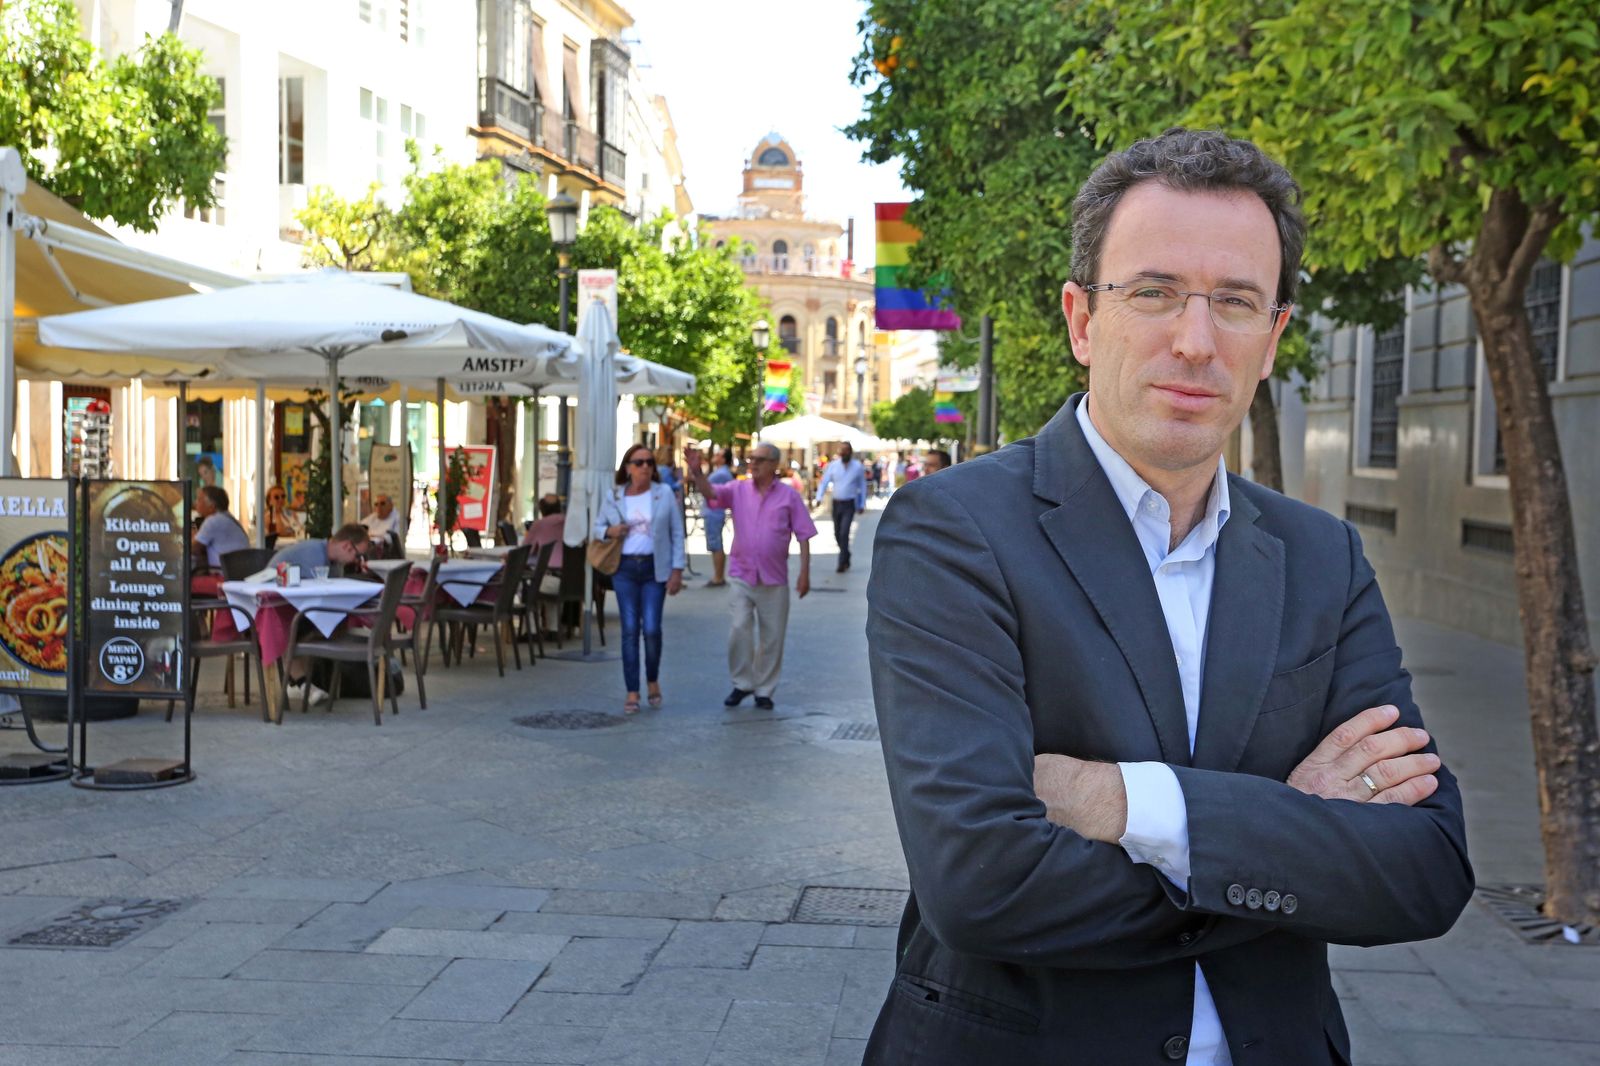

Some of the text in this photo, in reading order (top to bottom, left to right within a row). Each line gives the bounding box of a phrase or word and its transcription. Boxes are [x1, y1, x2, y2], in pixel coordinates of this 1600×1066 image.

[104, 518, 170, 533] Kitchen
[116, 537, 160, 555] Open
[110, 557, 166, 575] all day
[110, 580, 165, 597] Lounge
[91, 597, 183, 614] dining room
[114, 615, 160, 630] inside
[108, 644, 138, 654] MENU
[107, 655, 138, 665] TAPAS
